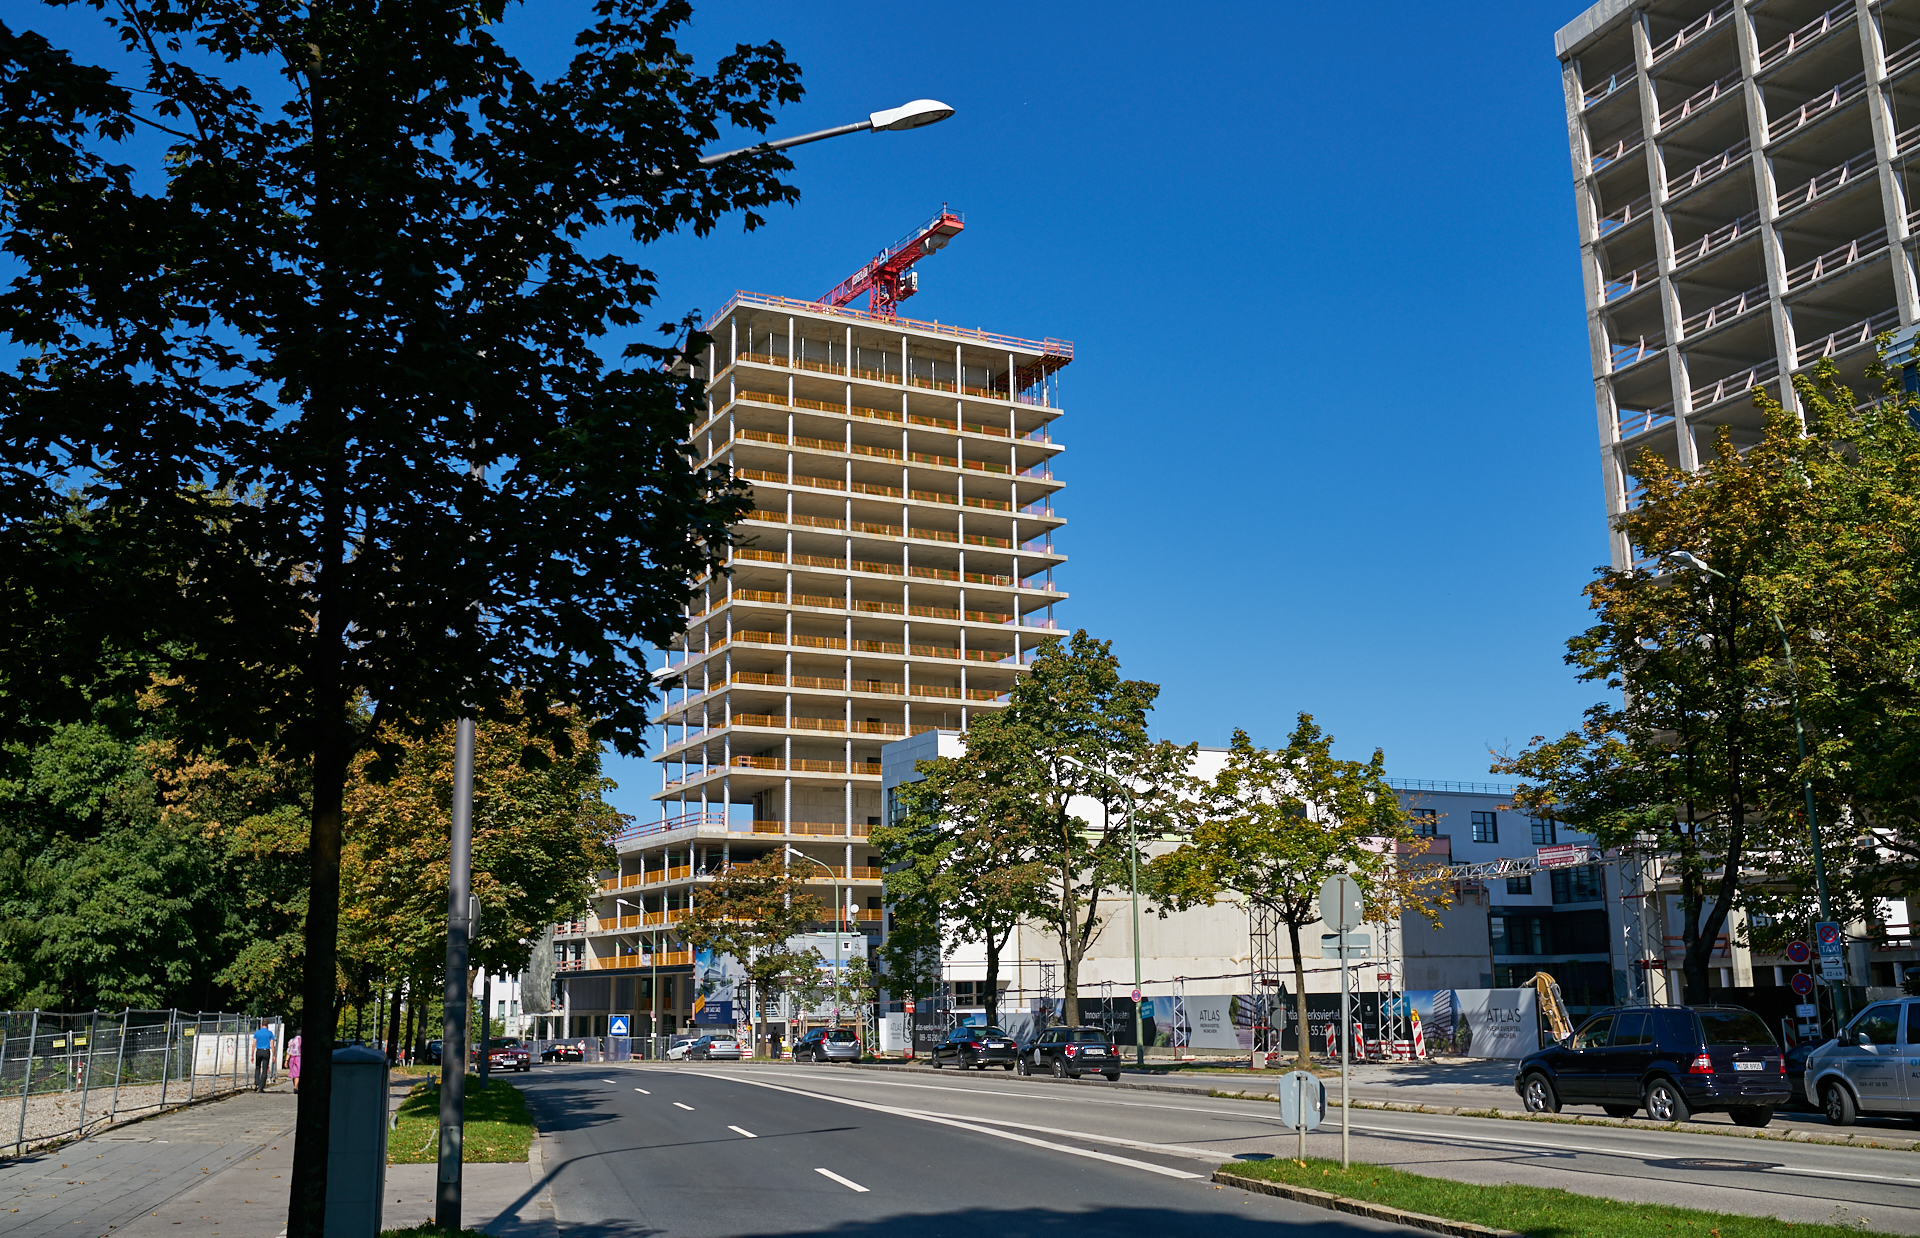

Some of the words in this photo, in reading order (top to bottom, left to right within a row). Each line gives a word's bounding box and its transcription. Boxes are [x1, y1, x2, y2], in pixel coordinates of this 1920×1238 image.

[1821, 945, 1839, 953] TAXI
[1200, 1010, 1220, 1021] ATLAS
[1487, 1008, 1521, 1022] ATLAS
[891, 1023, 903, 1032] ATLAS
[1311, 1025, 1319, 1035] 55
